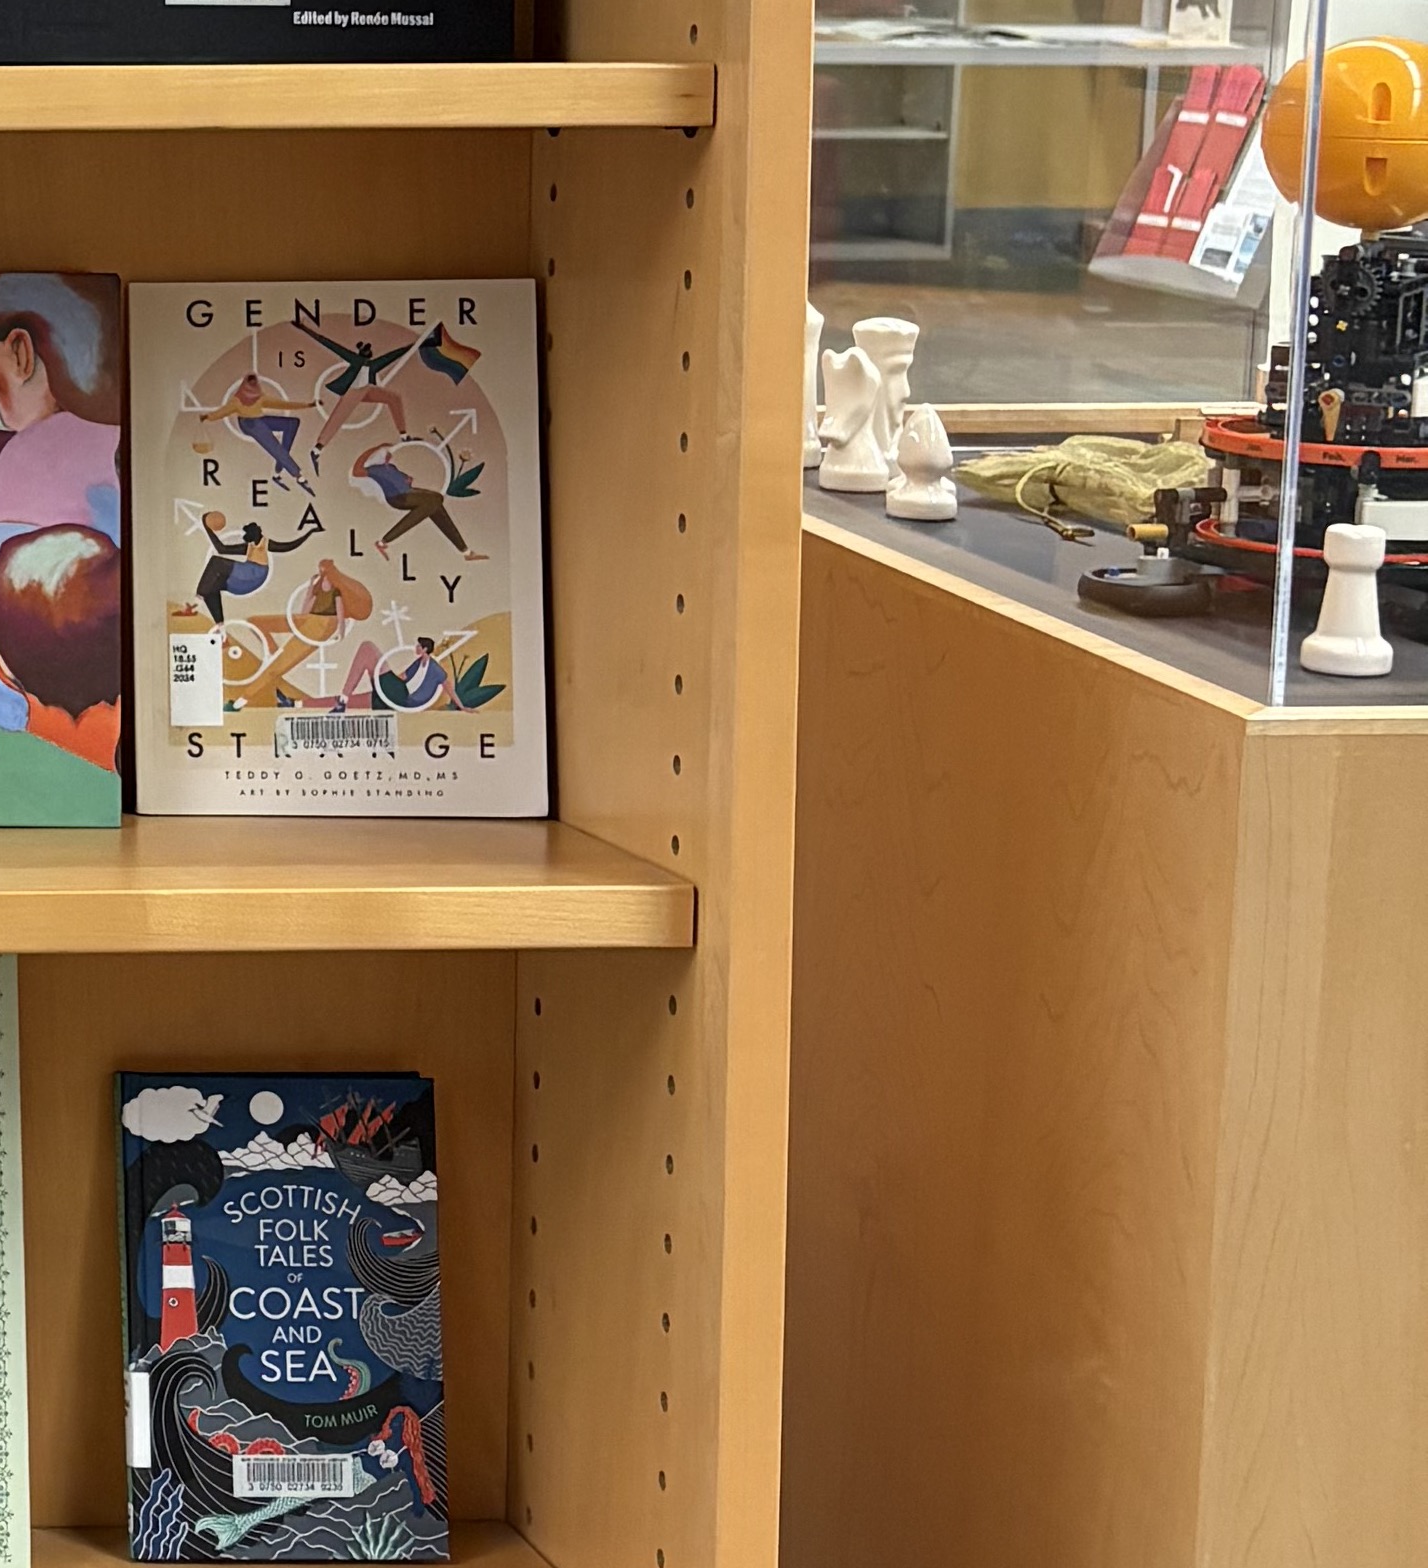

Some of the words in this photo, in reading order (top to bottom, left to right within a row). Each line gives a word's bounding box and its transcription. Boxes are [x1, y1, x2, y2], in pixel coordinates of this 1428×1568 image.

[186, 298, 477, 328] GENDER
[278, 351, 305, 368] IS
[223, 1185, 362, 1225] SCOTTISH
[259, 1219, 329, 1242] FOLK
[255, 1245, 333, 1267] TALES
[229, 1288, 364, 1320] COAST
[261, 1351, 338, 1382] SEA
